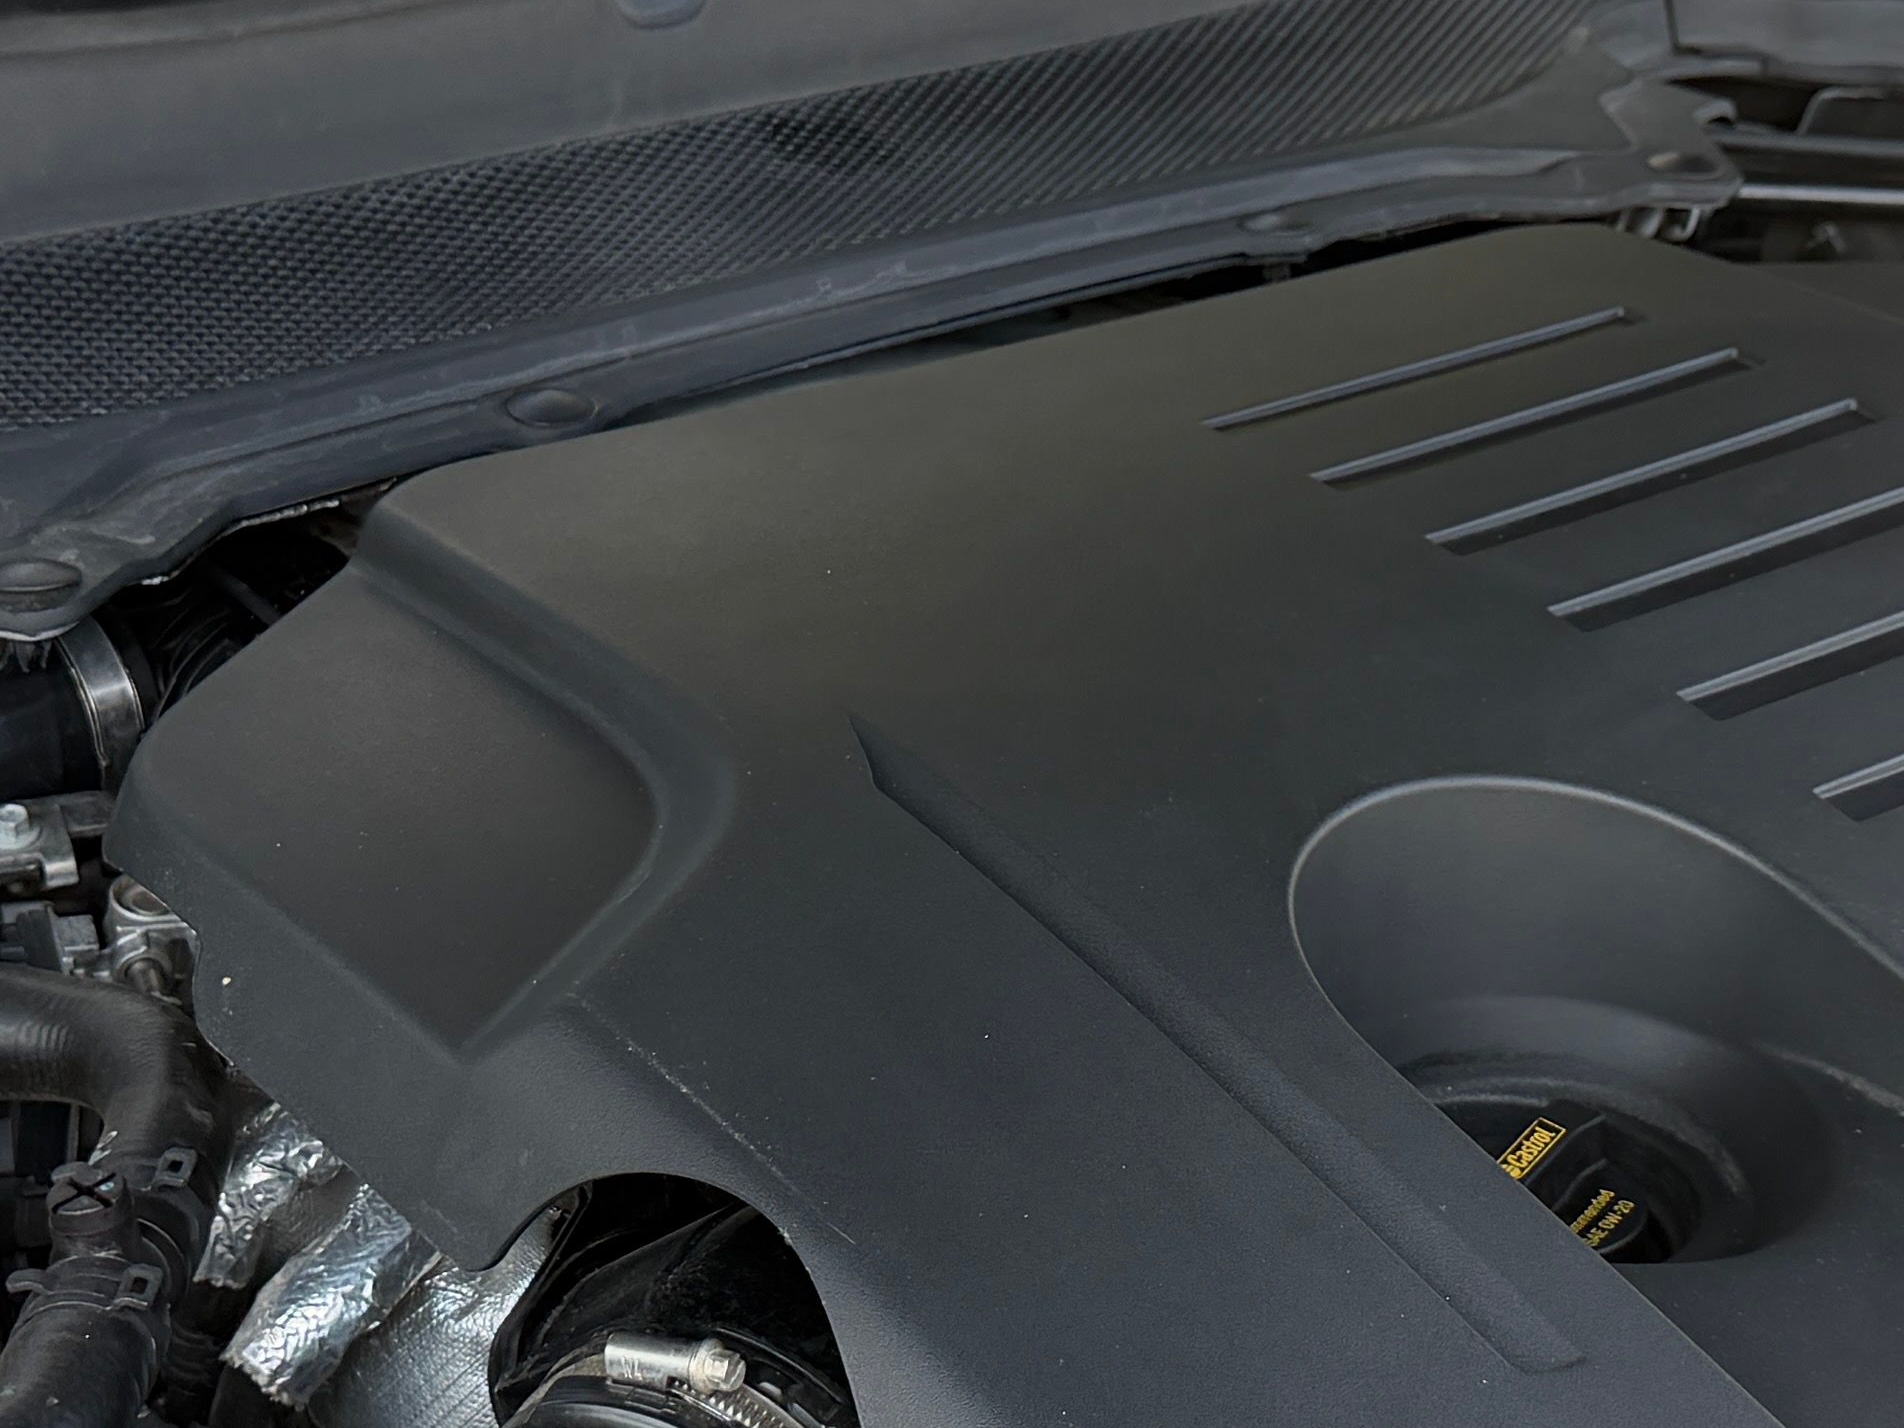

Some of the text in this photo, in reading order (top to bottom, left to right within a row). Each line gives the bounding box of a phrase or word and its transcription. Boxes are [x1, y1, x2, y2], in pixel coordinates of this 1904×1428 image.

[1507, 1127, 1556, 1168] Castrol
[1569, 1189, 1615, 1235] mmended
[1598, 1200, 1635, 1230] 0W-20
